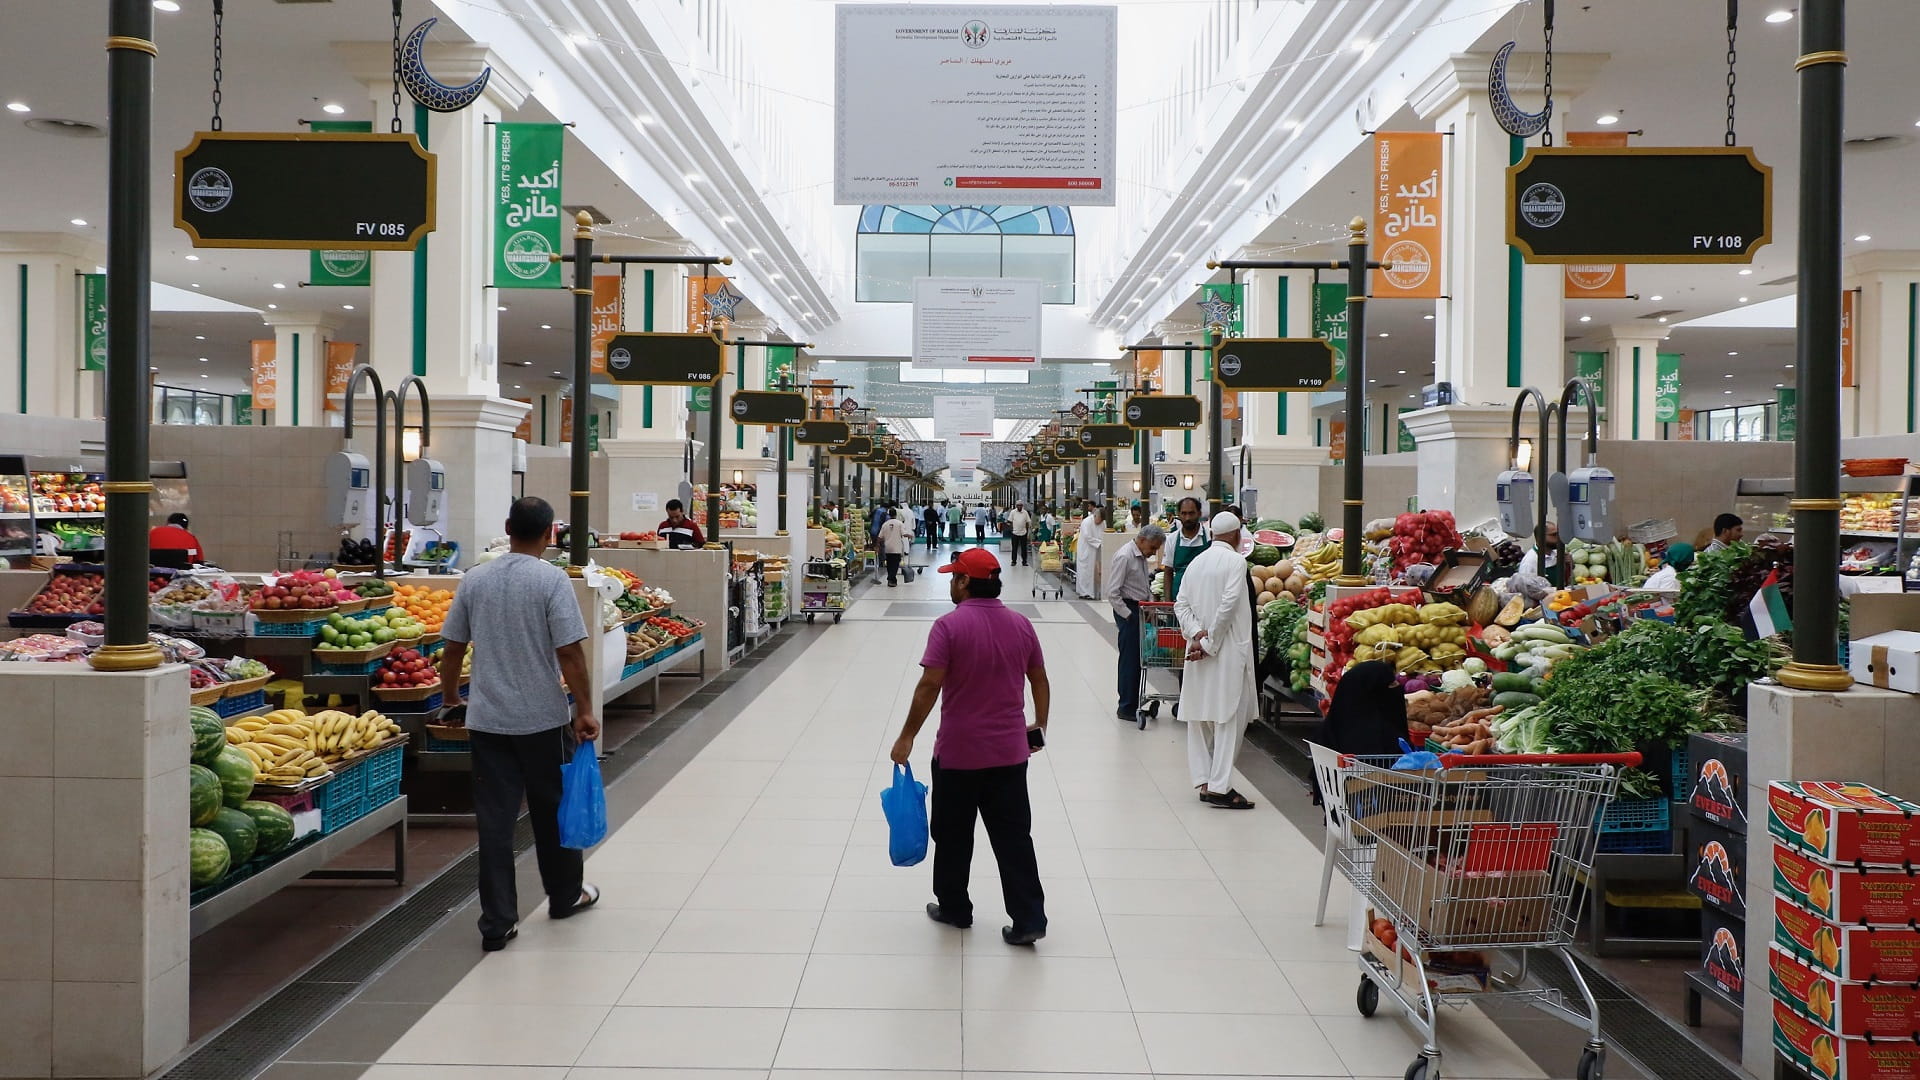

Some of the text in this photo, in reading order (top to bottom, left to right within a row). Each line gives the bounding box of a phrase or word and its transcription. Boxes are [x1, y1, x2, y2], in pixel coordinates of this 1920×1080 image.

[501, 131, 511, 205] YES, IT'S FRESH
[517, 160, 559, 195] أكيد
[1380, 140, 1390, 215] YES, IT'S FRESH
[1395, 169, 1438, 204] أكيد
[505, 195, 558, 228] طازج
[1384, 205, 1437, 238] طازج
[356, 222, 405, 236] FV 085
[1693, 236, 1742, 248] FV 108
[593, 297, 618, 317] أكيد
[1660, 369, 1679, 383] أكيد
[1695, 795, 1733, 819] EVEREST
[1858, 821, 1910, 832] NATIONAL
[1697, 876, 1733, 904] EVEREST
[1860, 882, 1913, 891] NATIONAL
[1708, 962, 1742, 992] EVEREST
[1862, 994, 1913, 1003] NATIONAL
